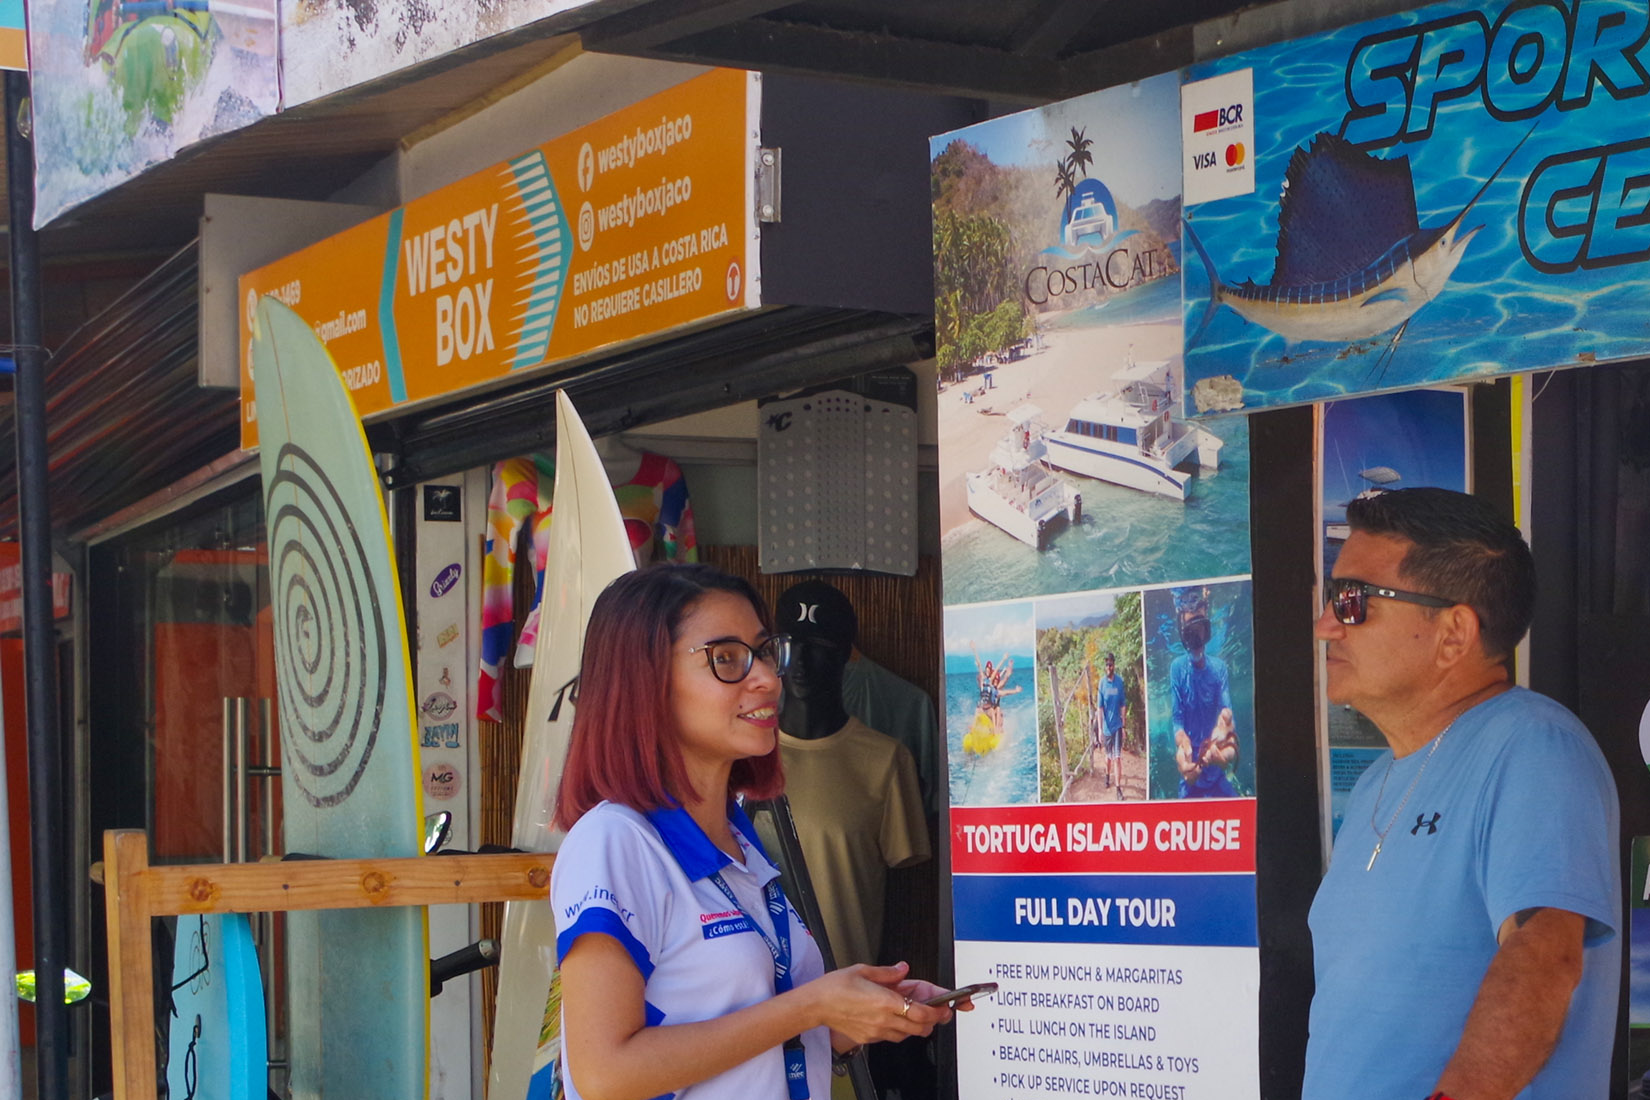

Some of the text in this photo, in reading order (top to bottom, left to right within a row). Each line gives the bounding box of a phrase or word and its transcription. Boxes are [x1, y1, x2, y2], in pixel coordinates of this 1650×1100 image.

[1219, 104, 1243, 127] BCR
[598, 114, 692, 173] westyboxjaco
[1193, 152, 1216, 170] VISA
[598, 176, 692, 232] westyboxjaco
[405, 203, 499, 297] WESTY
[573, 223, 728, 296] ENVÍOS COSTA RICA
[591, 267, 703, 323] REQUIERE CASILLERO
[436, 278, 494, 367] BOX
[964, 819, 1241, 853] TORTUGA ISLAND CRUISE
[1015, 898, 1176, 928] FULL DAY TOUR
[996, 964, 1183, 985] FREE RUM PUNCH MARGARITAS
[998, 991, 1160, 1013] LIGHT BREAKFAST ON BOARD
[999, 1018, 1156, 1042] FULL LUNCH ON THE ISLAND
[1000, 1046, 1200, 1074] BEACH UMBRELLAS TOYS
[1000, 1073, 1025, 1090] PICK
[1028, 1074, 1043, 1091] UP
[1045, 1076, 1090, 1094] SERVICE
[1093, 1078, 1127, 1097] UPON
